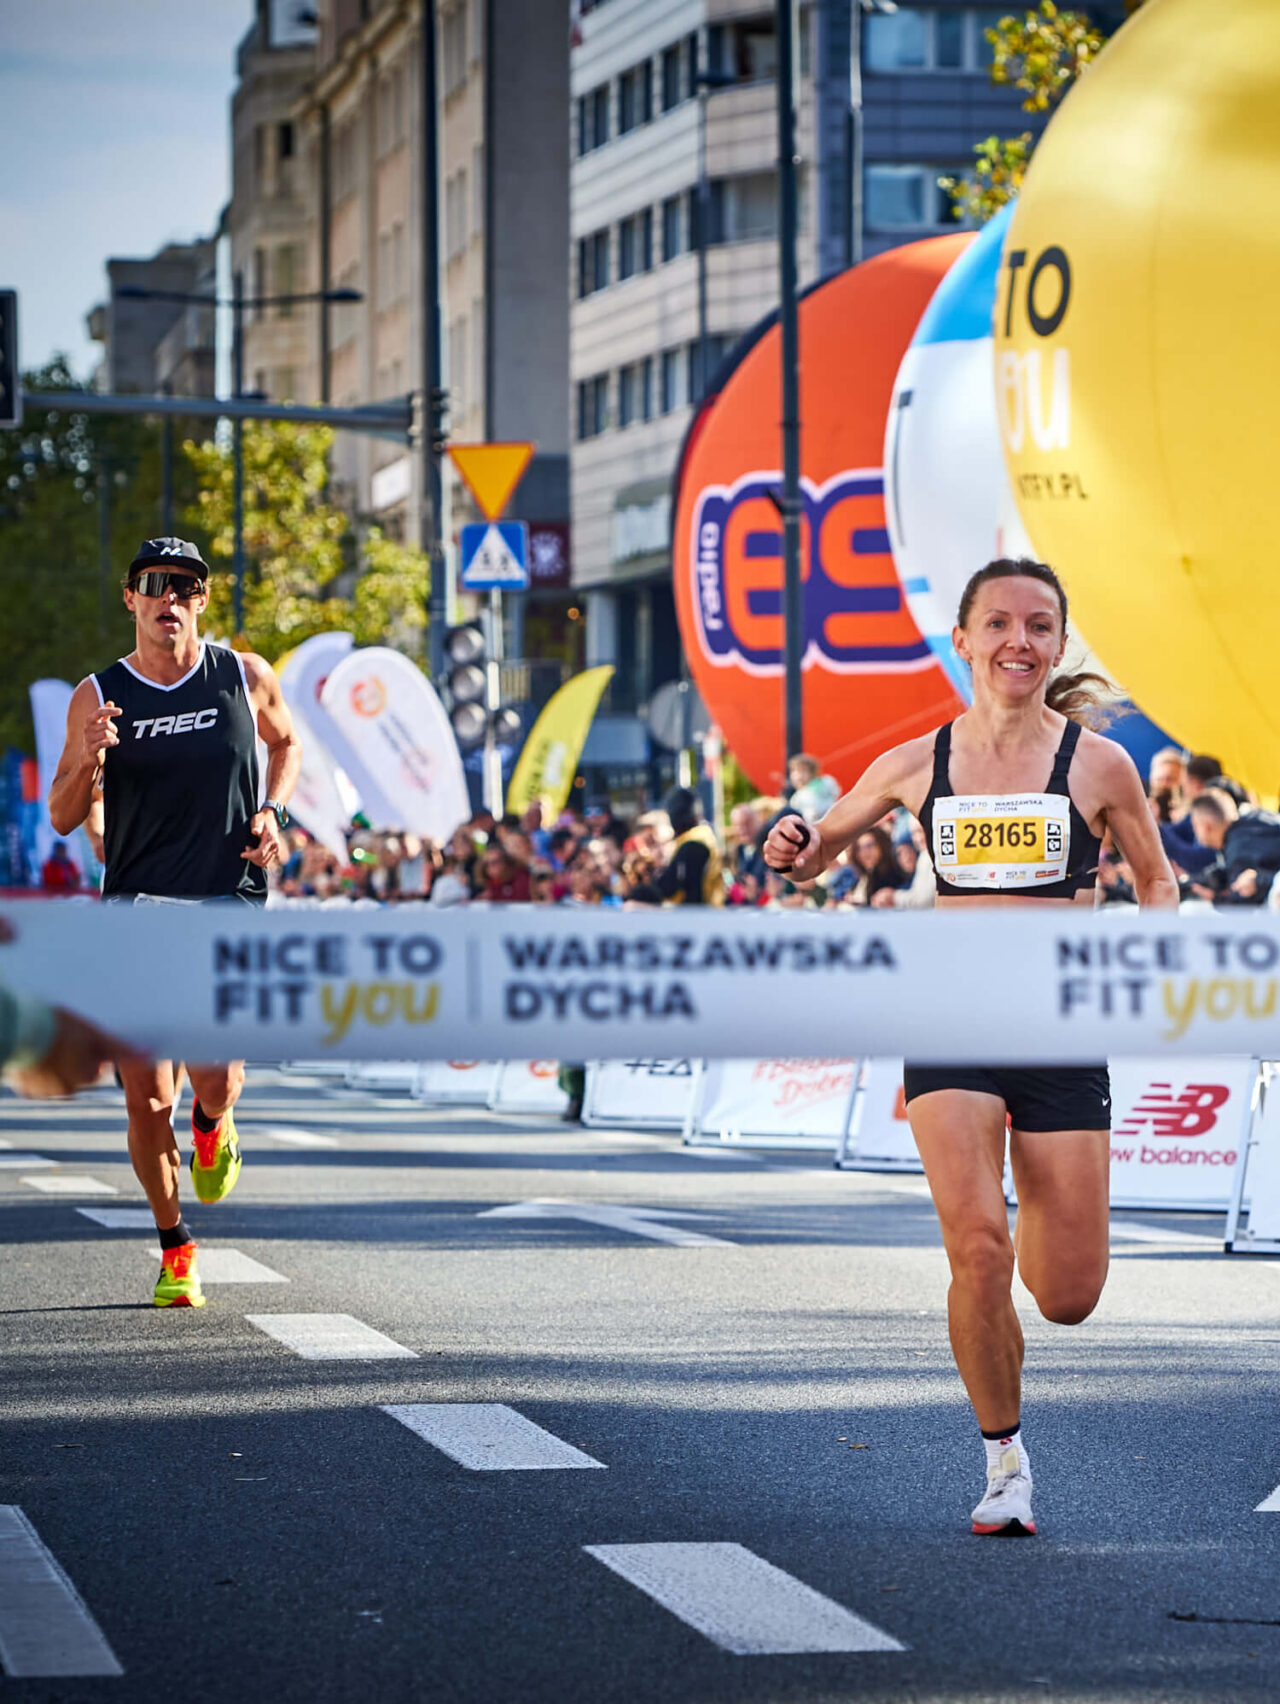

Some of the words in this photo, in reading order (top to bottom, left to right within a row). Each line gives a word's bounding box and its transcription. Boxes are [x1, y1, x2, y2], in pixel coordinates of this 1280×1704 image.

[1003, 245, 1074, 338] TO
[698, 521, 724, 632] radio
[132, 708, 218, 739] TREC
[963, 822, 1037, 848] 28165
[214, 934, 346, 976] NICE
[363, 934, 443, 976] TO
[504, 935, 897, 971] WARSZAWSKA
[1058, 933, 1185, 972] NICE
[214, 981, 311, 1024] FIT
[318, 980, 439, 1049] you
[504, 981, 697, 1021] DYCHA
[1059, 977, 1152, 1018] FIT
[1160, 975, 1279, 1042] you
[1140, 1144, 1238, 1166] balance
